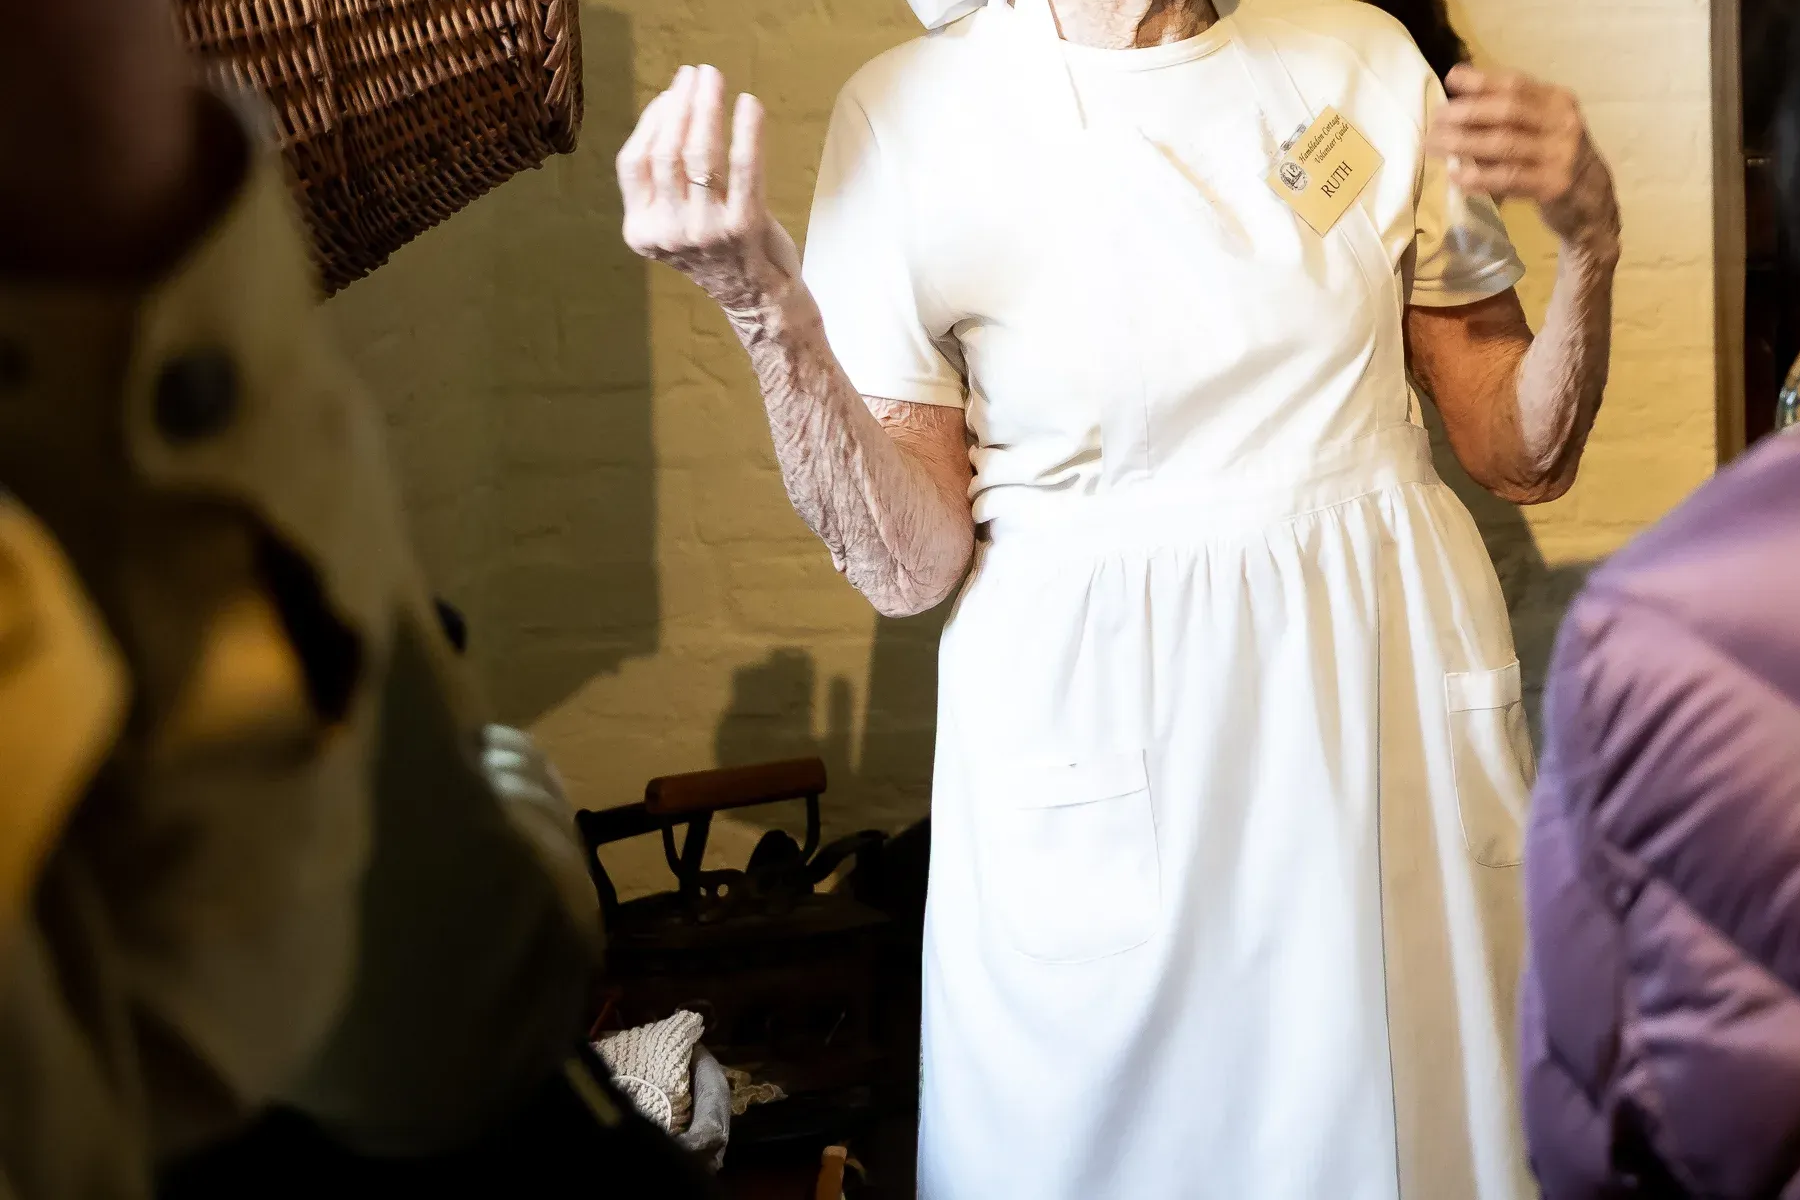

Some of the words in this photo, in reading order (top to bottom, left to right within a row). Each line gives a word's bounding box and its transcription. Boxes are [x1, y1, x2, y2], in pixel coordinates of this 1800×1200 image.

[1298, 133, 1325, 165] Hambledon
[1322, 114, 1341, 137] Cottage
[1314, 138, 1337, 164] Volunteer
[1335, 123, 1349, 142] Guide
[1320, 160, 1353, 198] RUTH
